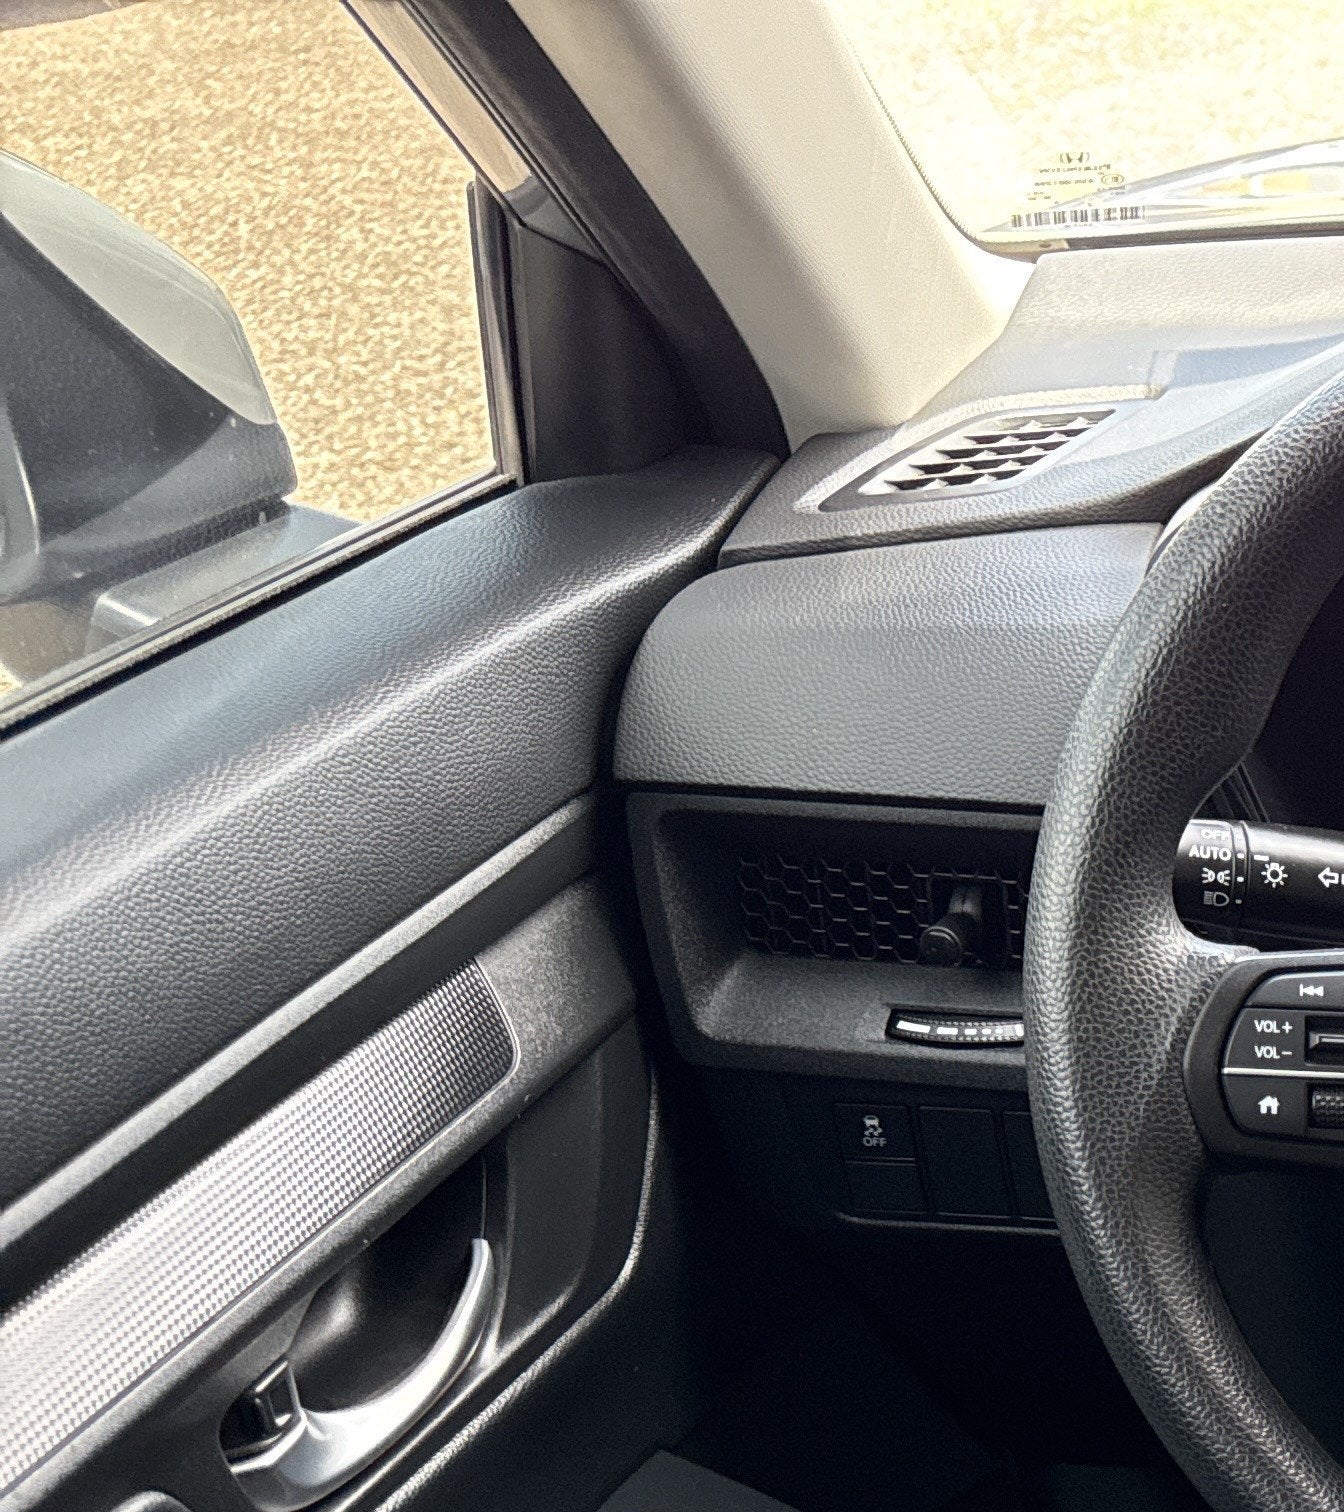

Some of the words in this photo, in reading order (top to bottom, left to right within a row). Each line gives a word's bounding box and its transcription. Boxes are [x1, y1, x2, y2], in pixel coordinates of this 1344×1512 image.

[1200, 828, 1230, 842] OFF
[1188, 844, 1232, 862] AUTO
[863, 1137, 888, 1148] OFF
